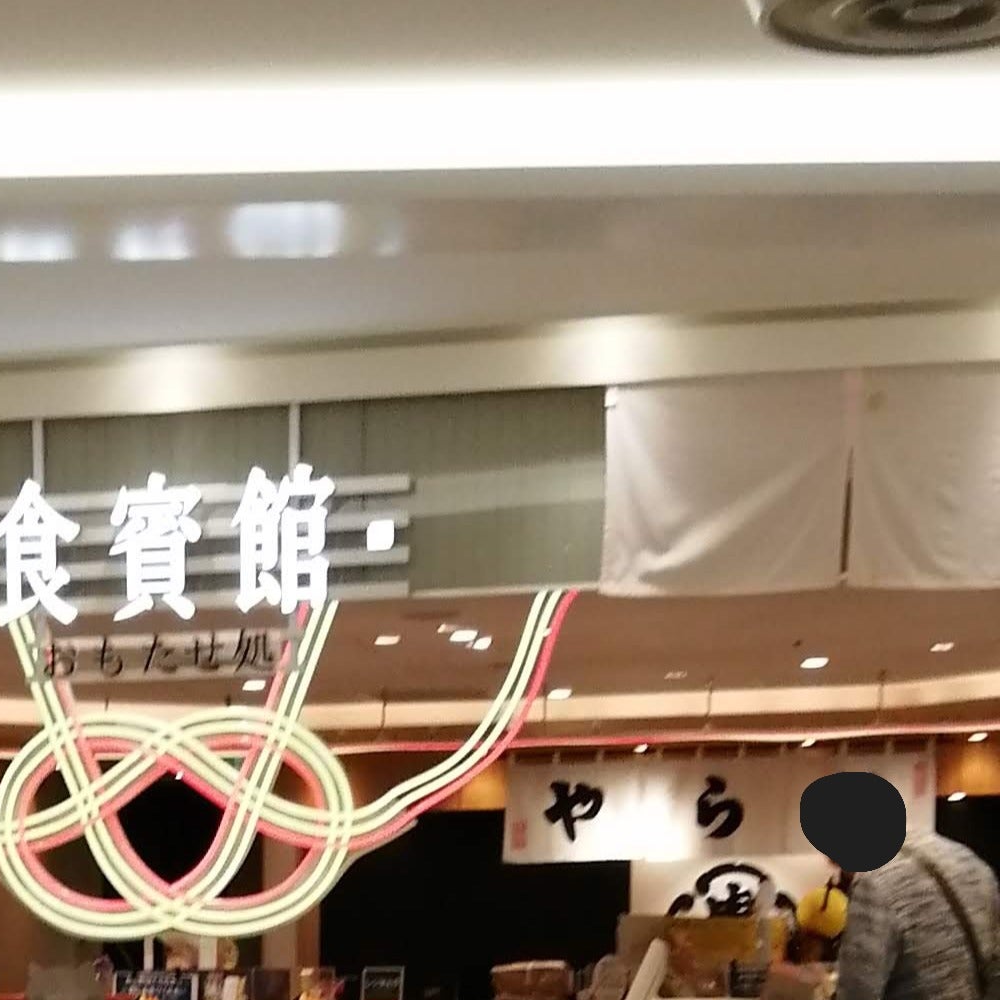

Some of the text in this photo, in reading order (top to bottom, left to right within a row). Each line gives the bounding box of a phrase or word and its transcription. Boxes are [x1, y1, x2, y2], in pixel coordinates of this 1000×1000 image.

[44, 628, 273, 678] おもたせ処
